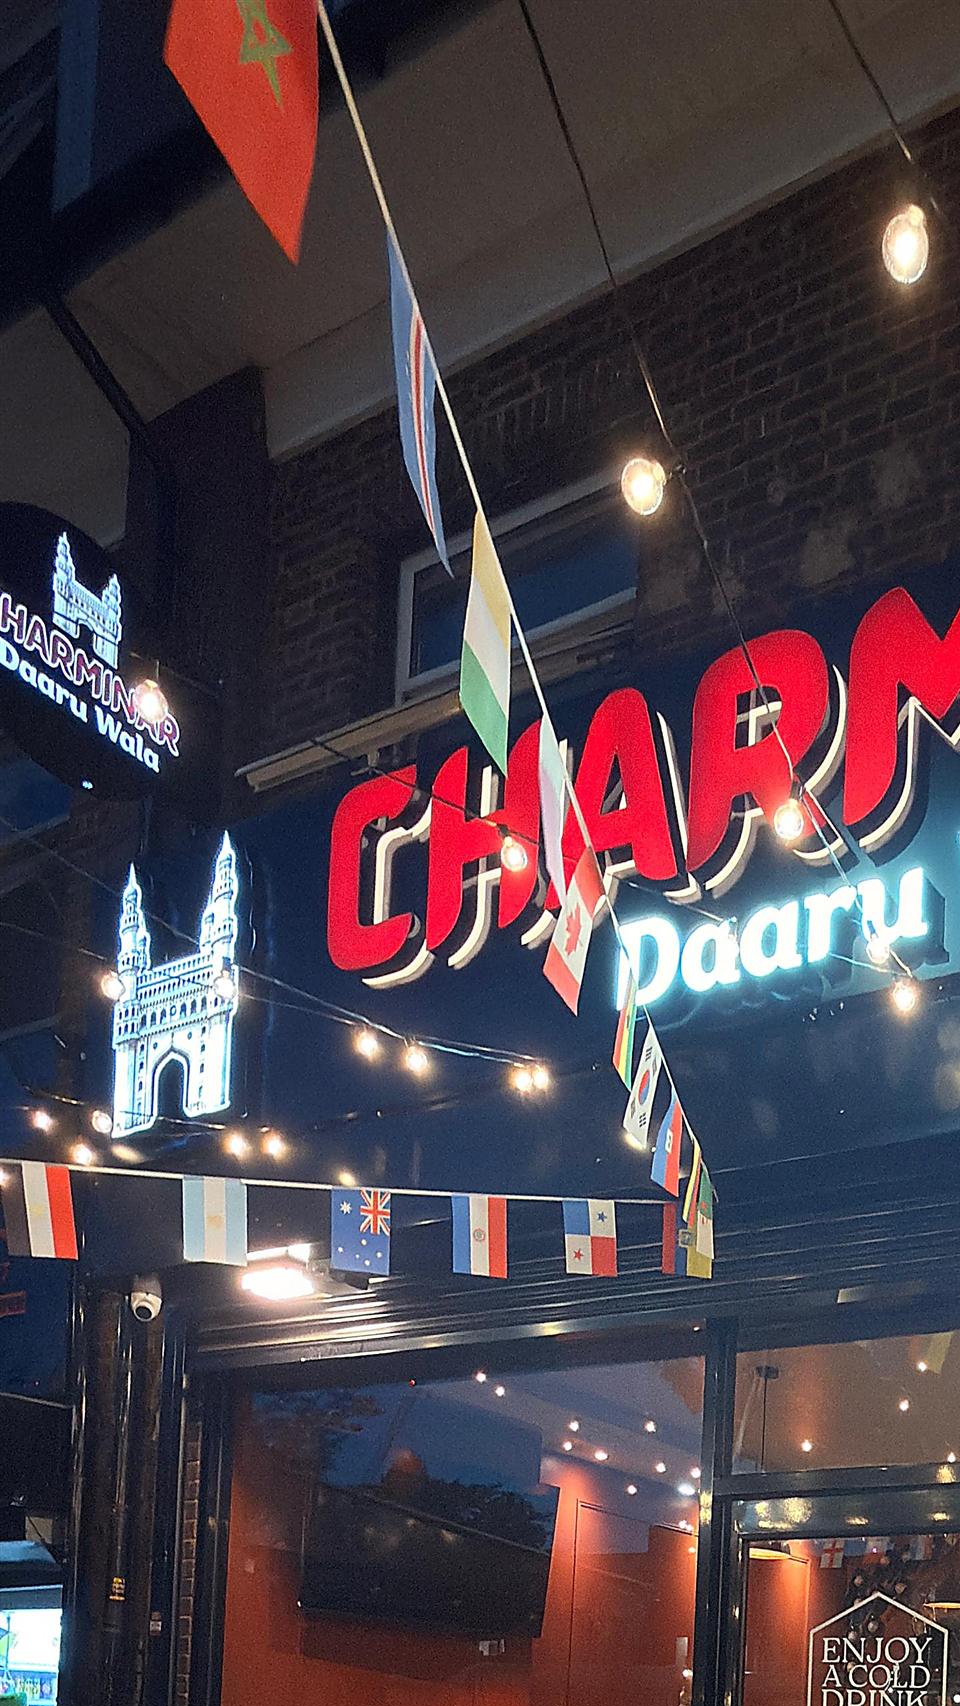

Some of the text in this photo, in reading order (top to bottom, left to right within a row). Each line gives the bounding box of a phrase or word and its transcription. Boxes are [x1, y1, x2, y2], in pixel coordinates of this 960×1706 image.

[0, 635, 160, 773] Daaru Wala
[614, 865, 929, 1006] Daaru
[822, 1637, 932, 1663] ENJOY
[822, 1664, 931, 1688] A COLD
